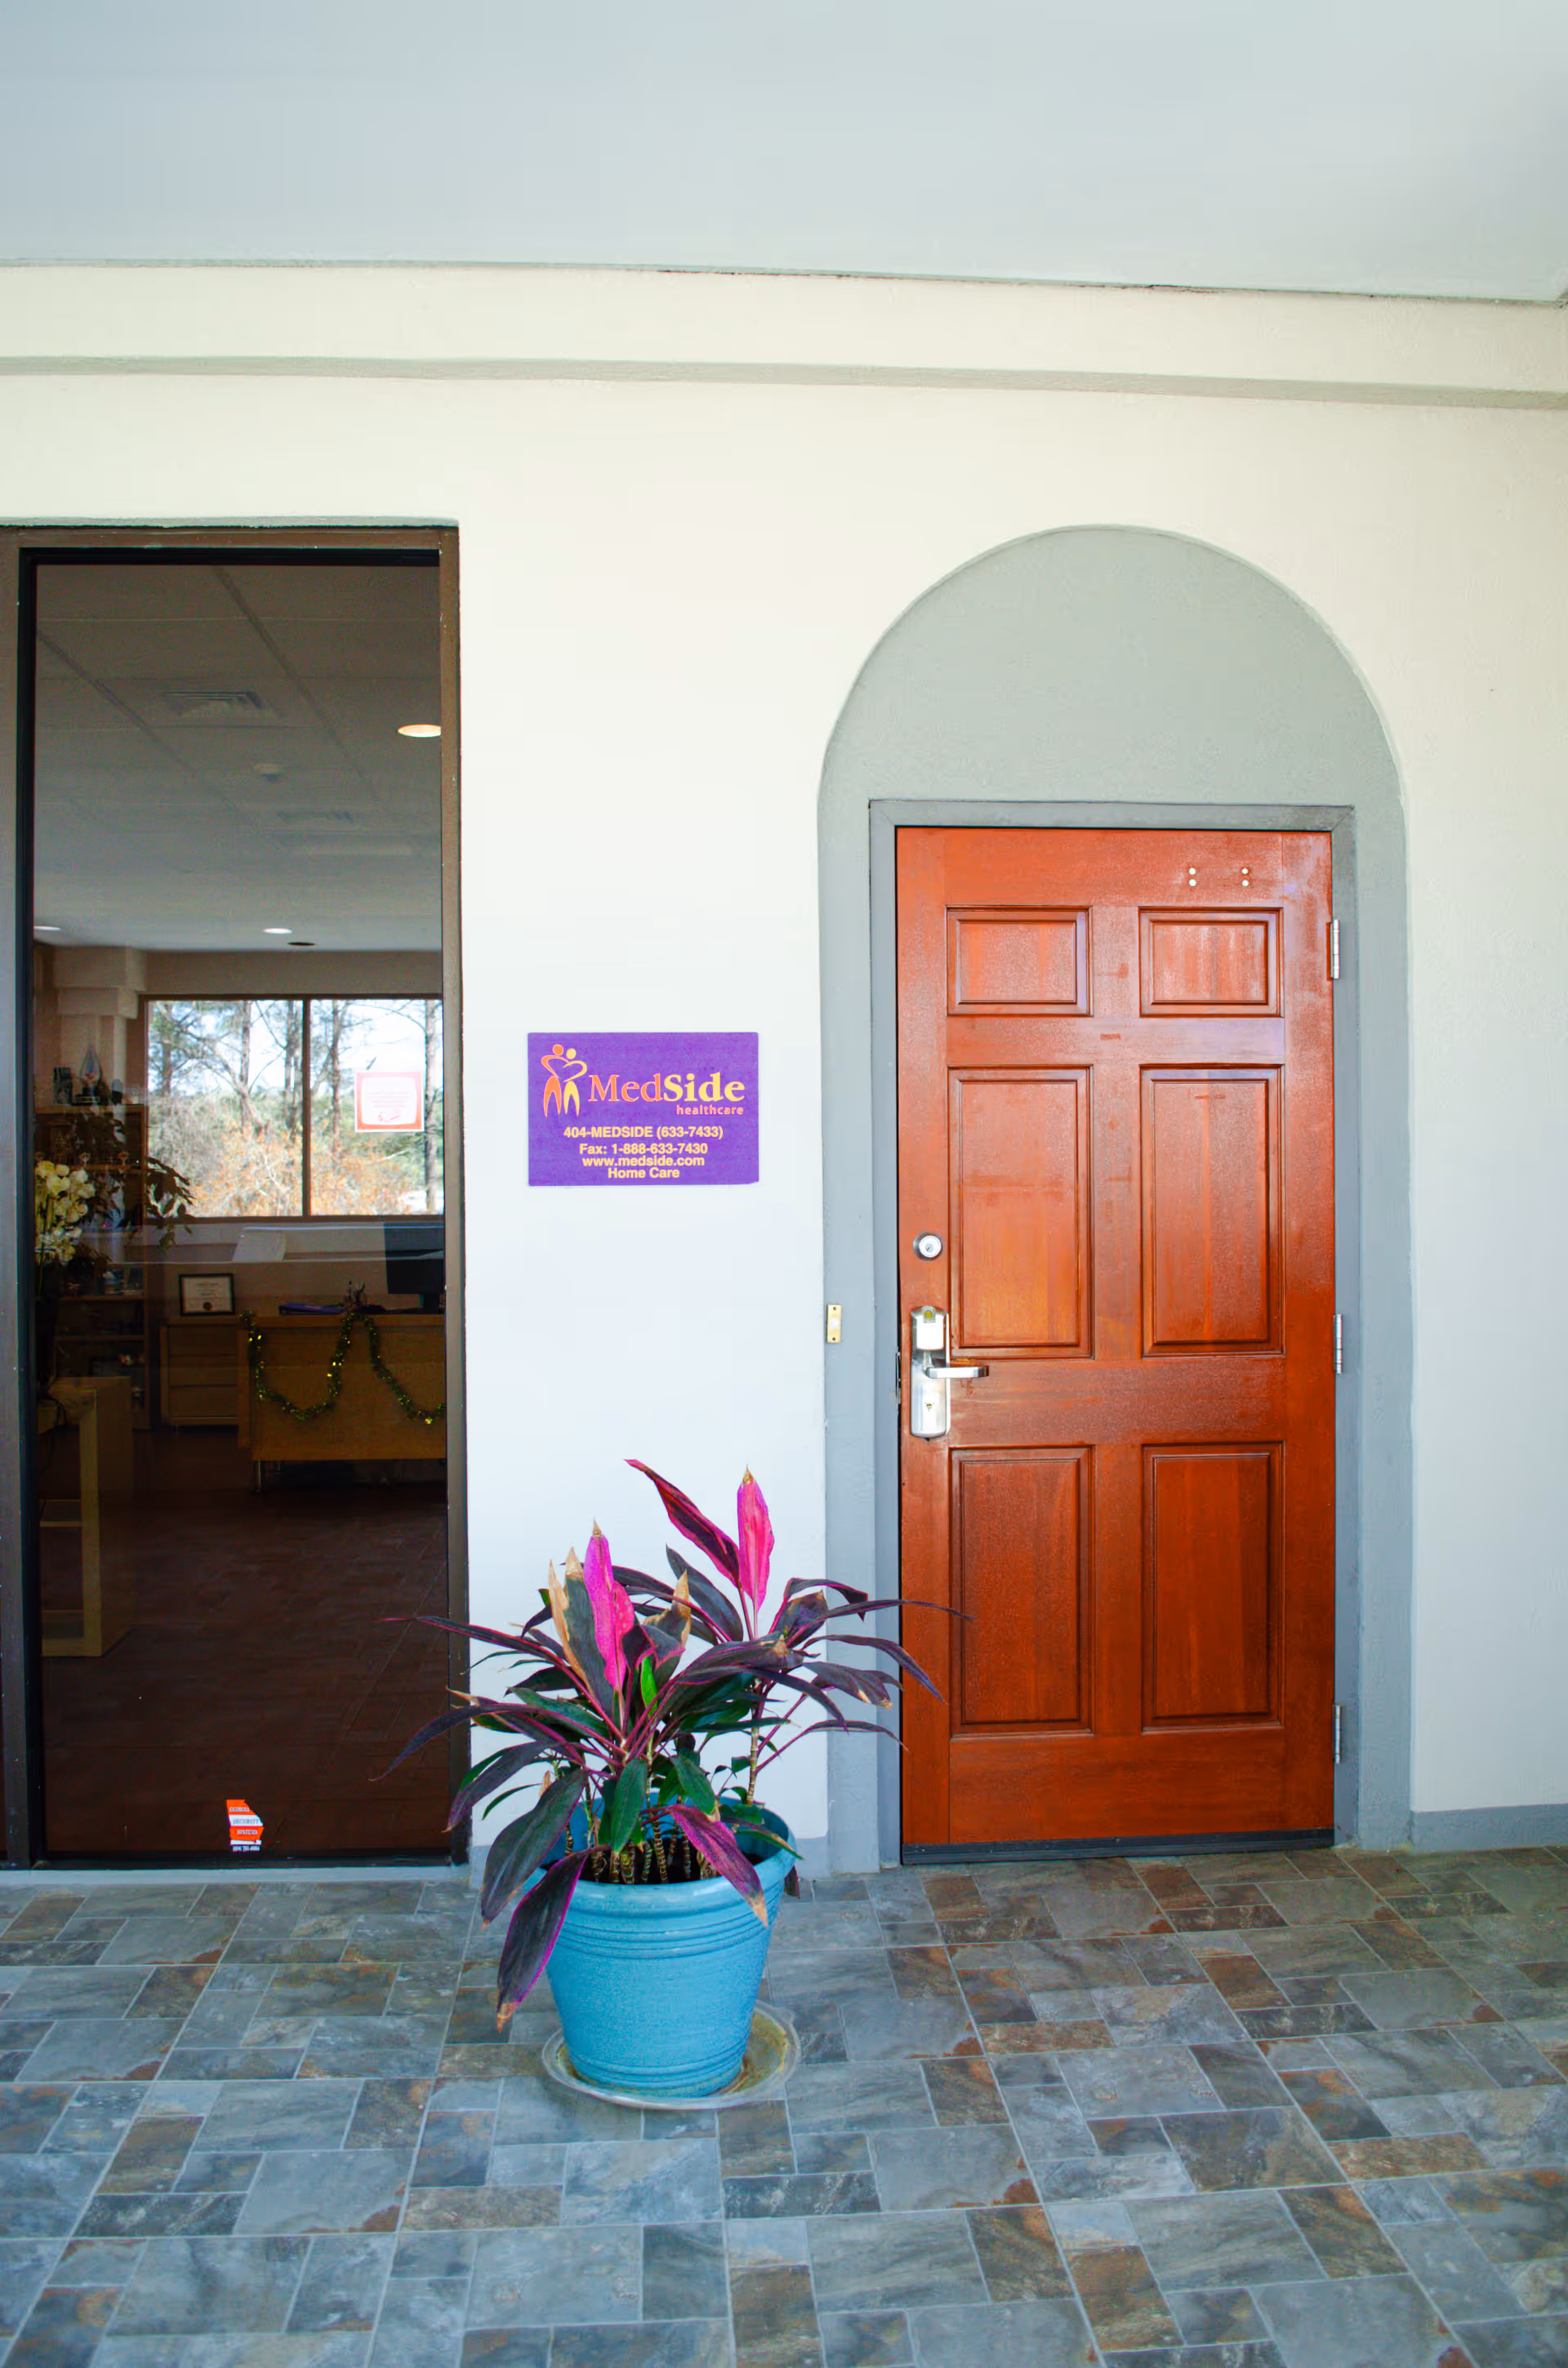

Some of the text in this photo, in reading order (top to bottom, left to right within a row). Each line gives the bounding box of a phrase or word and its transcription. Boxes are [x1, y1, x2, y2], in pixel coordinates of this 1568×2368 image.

[588, 1072, 745, 1102] MedSide
[676, 1104, 744, 1115] healthcare
[564, 1126, 724, 1139] 404-MEDSIDE (633-7433)
[579, 1144, 708, 1154] Fax: 1-888-633-7430
[582, 1155, 705, 1166] www.medside.com
[608, 1167, 679, 1178] Home Care
